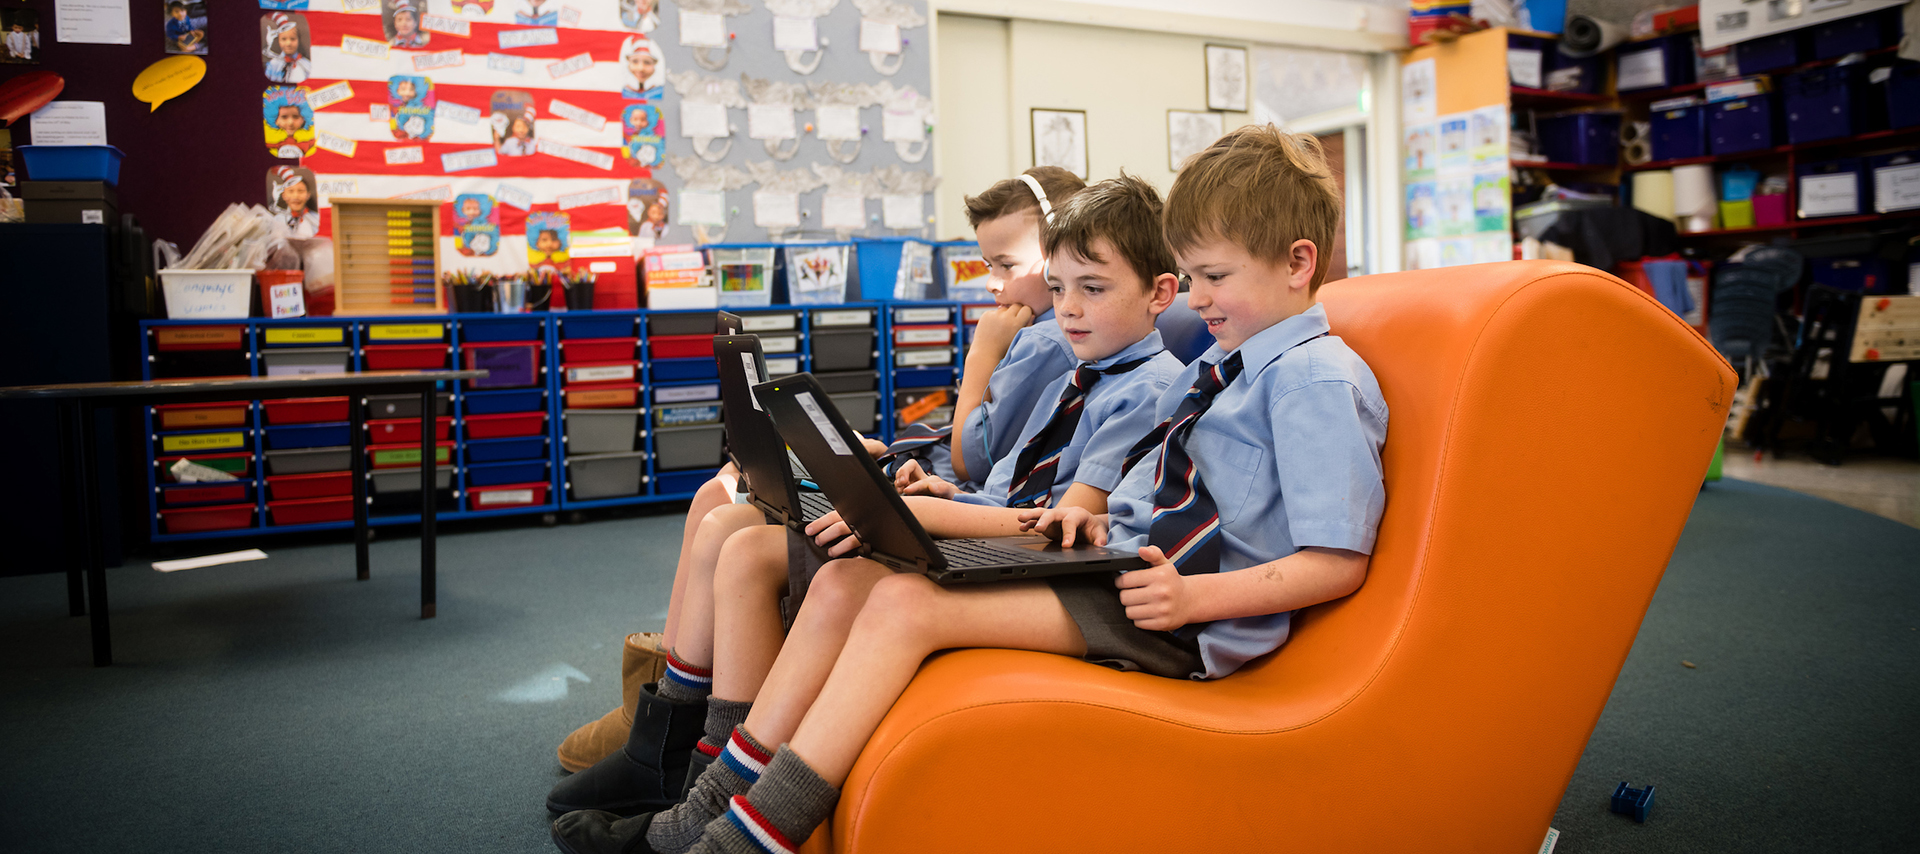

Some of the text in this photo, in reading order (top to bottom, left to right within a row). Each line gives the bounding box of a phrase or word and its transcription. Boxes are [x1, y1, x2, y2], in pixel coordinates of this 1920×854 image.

[423, 16, 468, 35] HAVE
[344, 38, 387, 57] YOUR
[415, 52, 457, 68] HEAD
[309, 83, 347, 107] FEET
[320, 133, 353, 154] YOU
[320, 180, 354, 194] ANY
[274, 287, 290, 299] Lost
